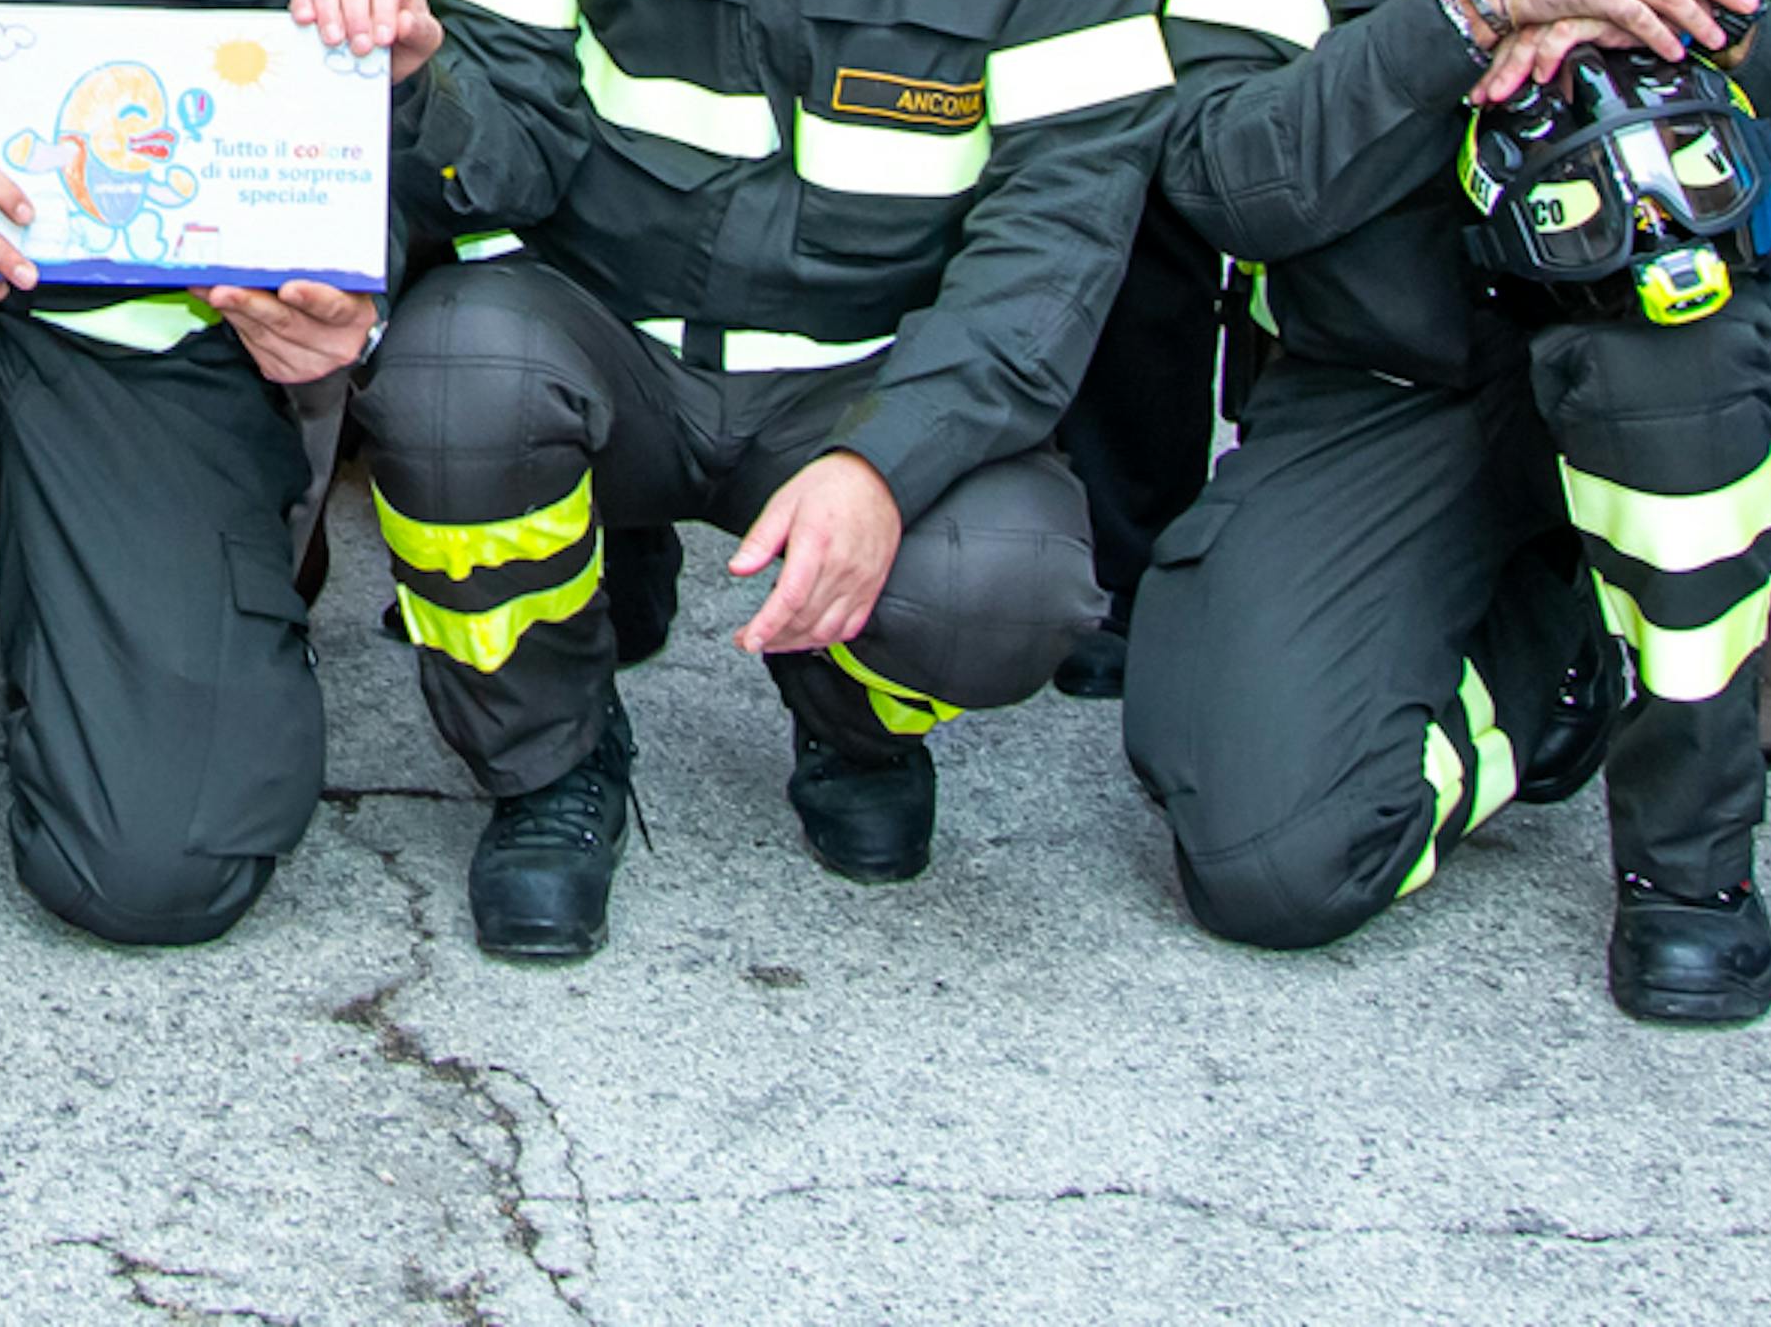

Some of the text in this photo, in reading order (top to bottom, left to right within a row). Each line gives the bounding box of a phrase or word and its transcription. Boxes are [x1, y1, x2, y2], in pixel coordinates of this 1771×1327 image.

[895, 88, 982, 117] ANCONA
[212, 137, 364, 160] Tutto il colore
[200, 161, 373, 186] di una sorpresa
[237, 184, 328, 206] speciale
